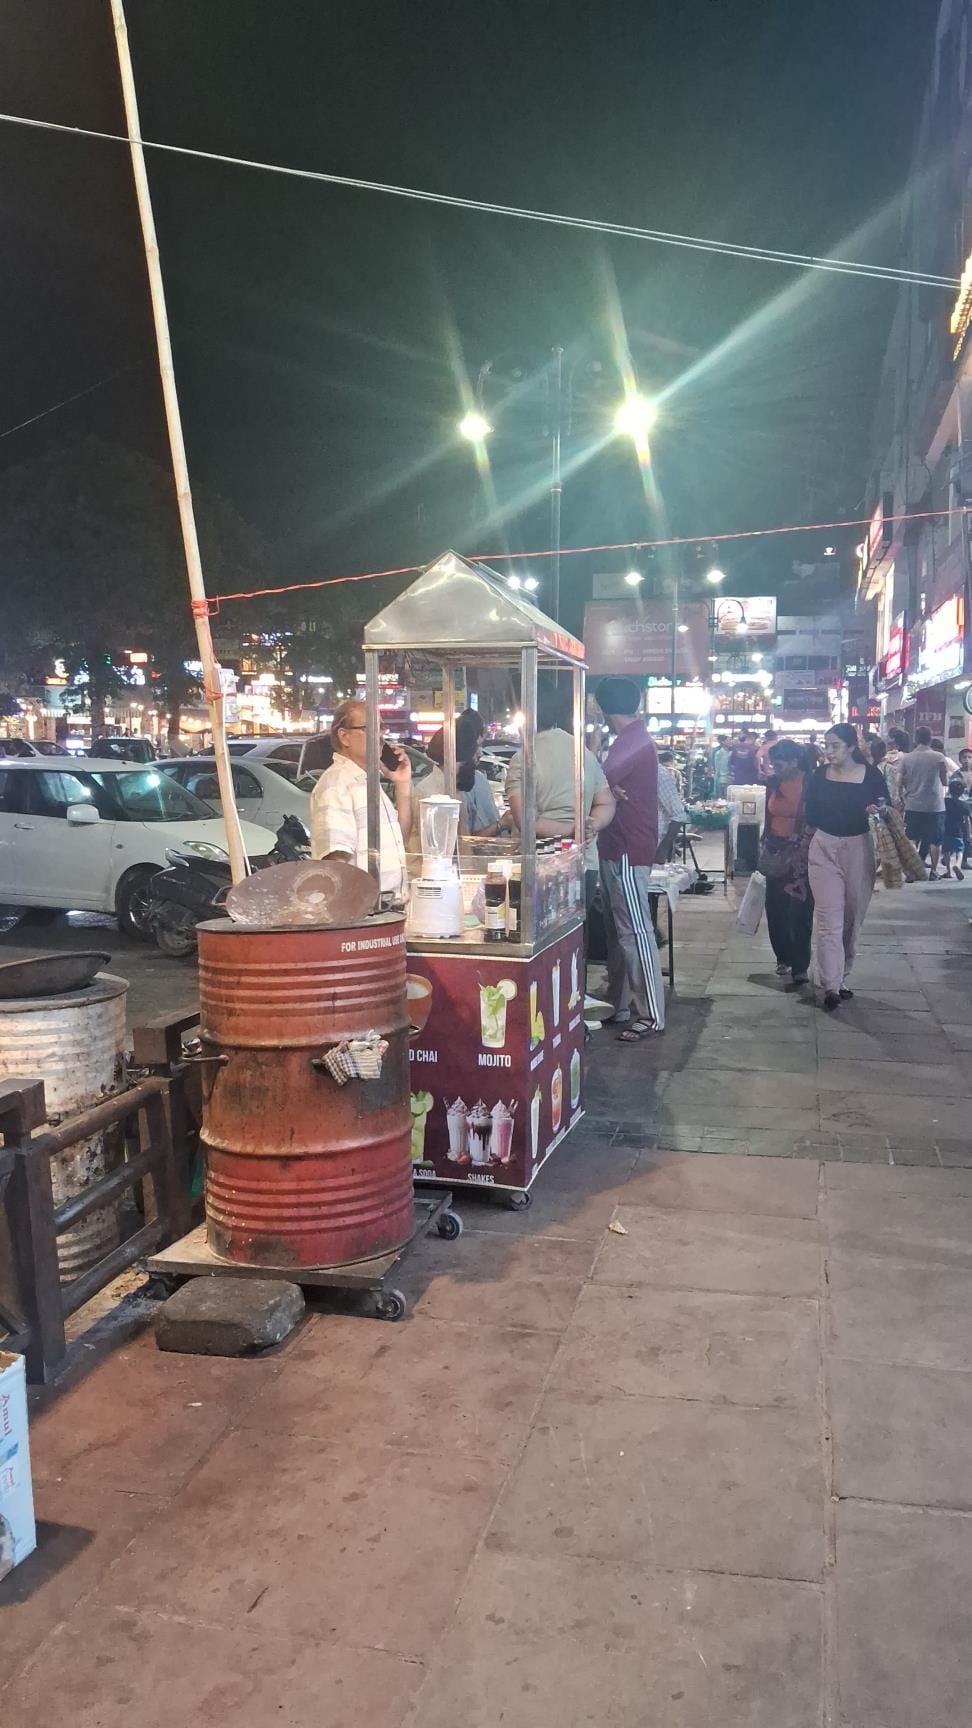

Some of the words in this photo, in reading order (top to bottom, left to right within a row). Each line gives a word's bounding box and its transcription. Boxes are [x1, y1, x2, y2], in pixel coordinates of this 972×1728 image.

[341, 941, 356, 953] FOR
[357, 937, 392, 951] INDUSTRIAL
[416, 1049, 438, 1063] CHAI
[478, 1053, 512, 1068] MOJITO
[419, 1168, 436, 1177] SODA
[467, 1173, 495, 1184] SHAKES
[1, 1393, 13, 1437] Amul
